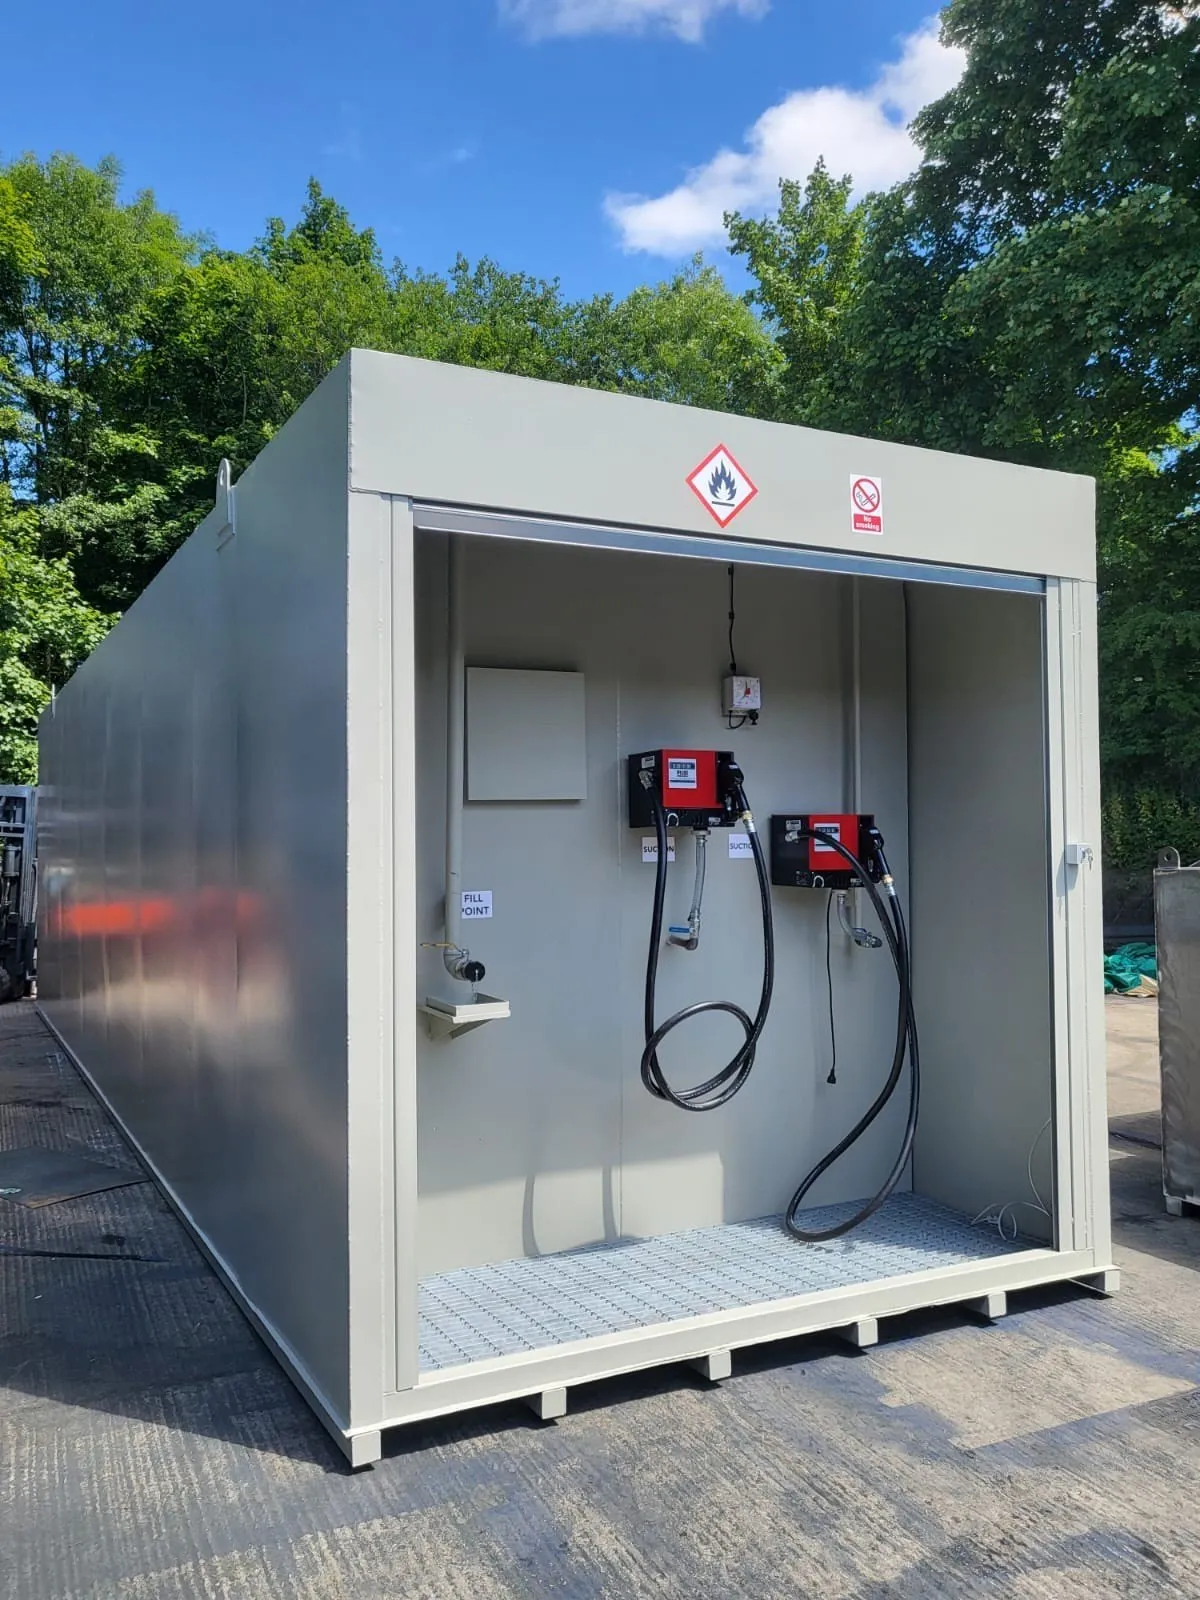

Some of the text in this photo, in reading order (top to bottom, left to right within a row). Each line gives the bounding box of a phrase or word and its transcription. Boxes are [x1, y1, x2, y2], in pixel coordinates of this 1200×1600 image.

[855, 522, 880, 531] smoking
[729, 842, 752, 850] SUCTIO
[464, 894, 483, 903] FILL
